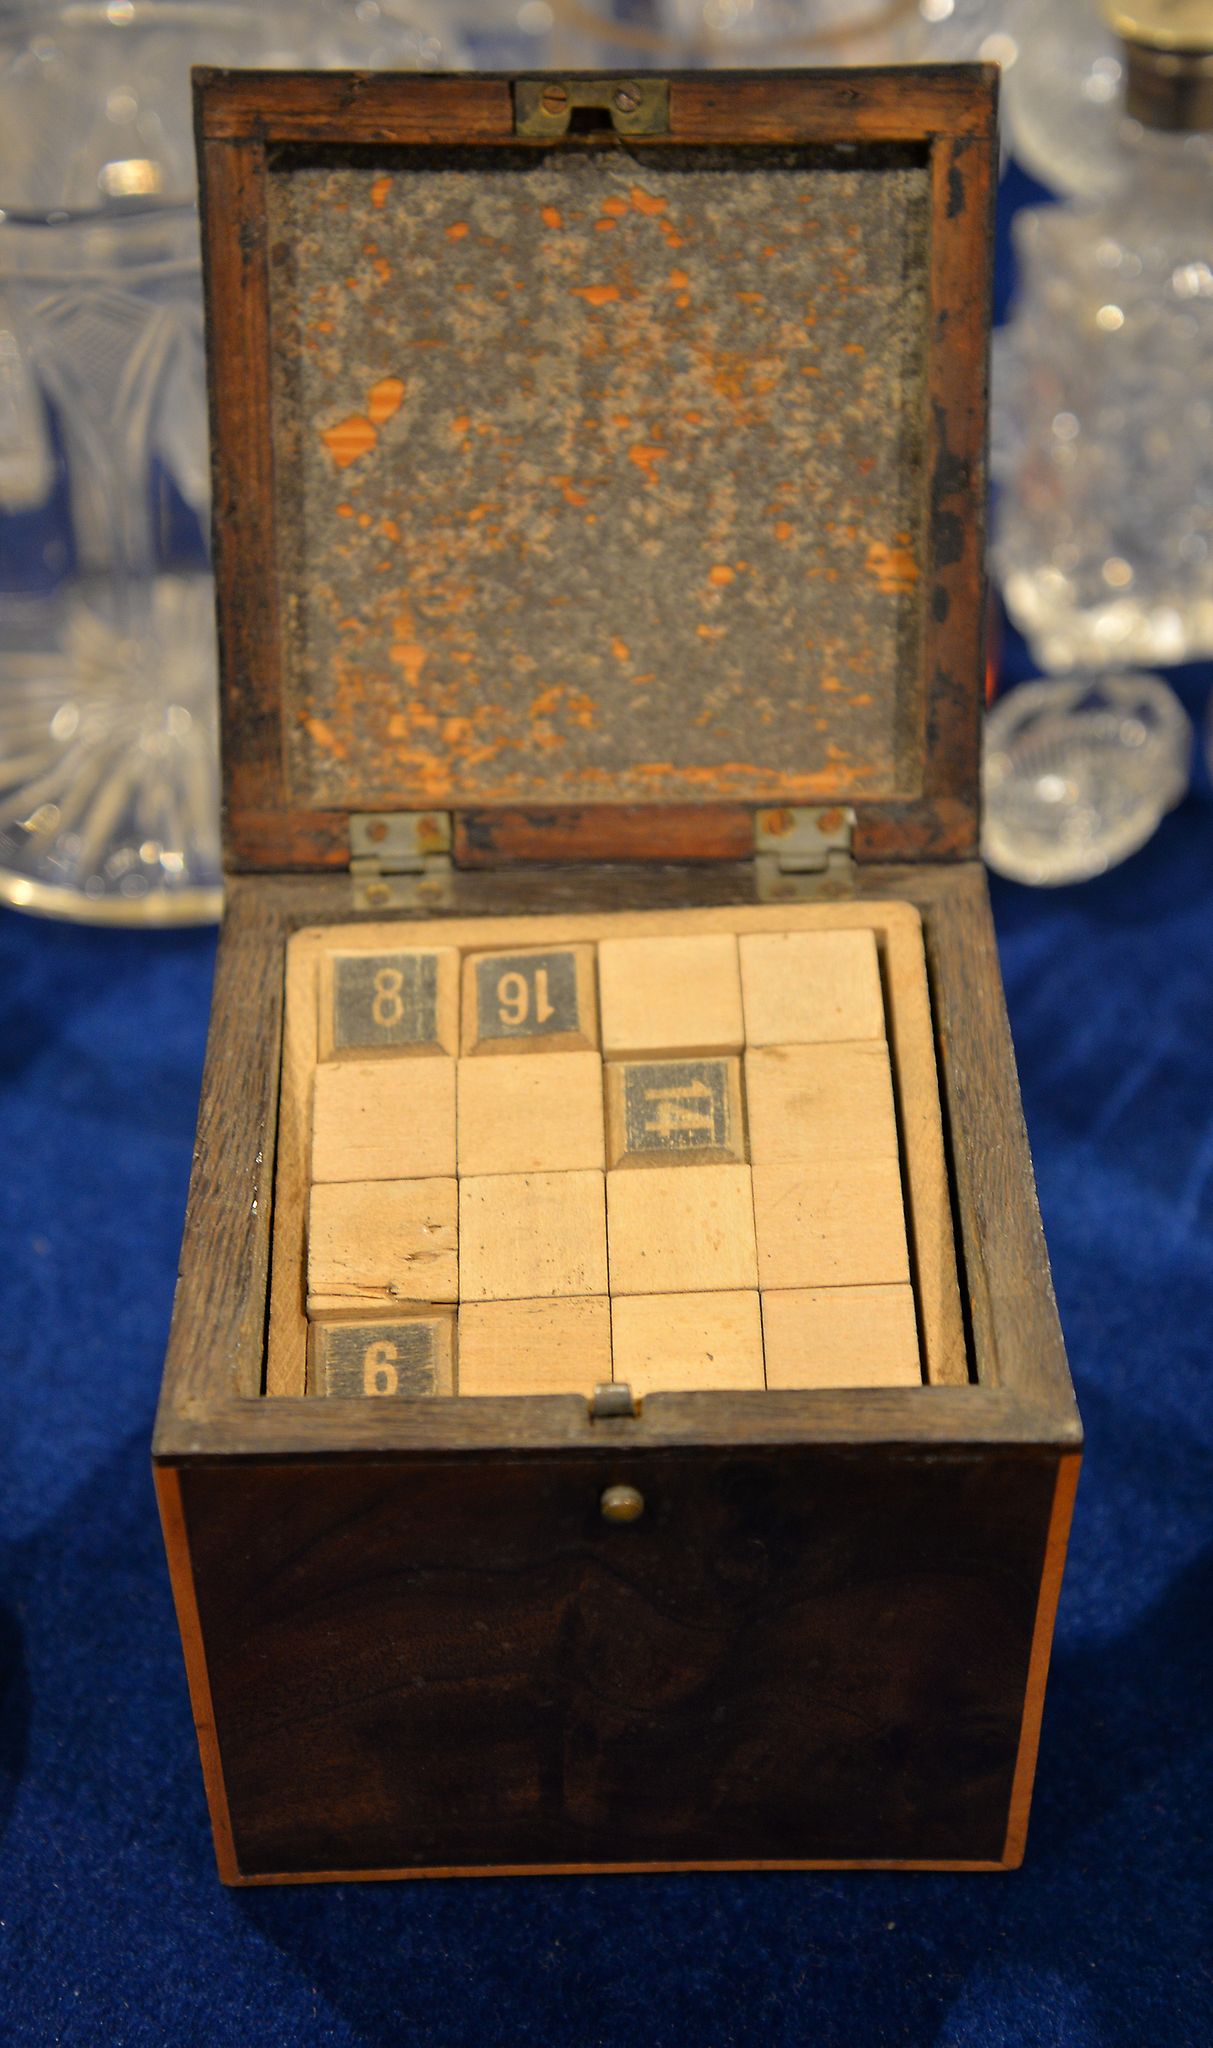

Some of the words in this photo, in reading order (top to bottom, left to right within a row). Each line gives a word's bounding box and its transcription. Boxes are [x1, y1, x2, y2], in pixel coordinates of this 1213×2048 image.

[372, 967, 404, 1027] 8
[497, 969, 555, 1025] 16
[645, 1079, 714, 1137] 14
[363, 1339, 399, 1397] 6
